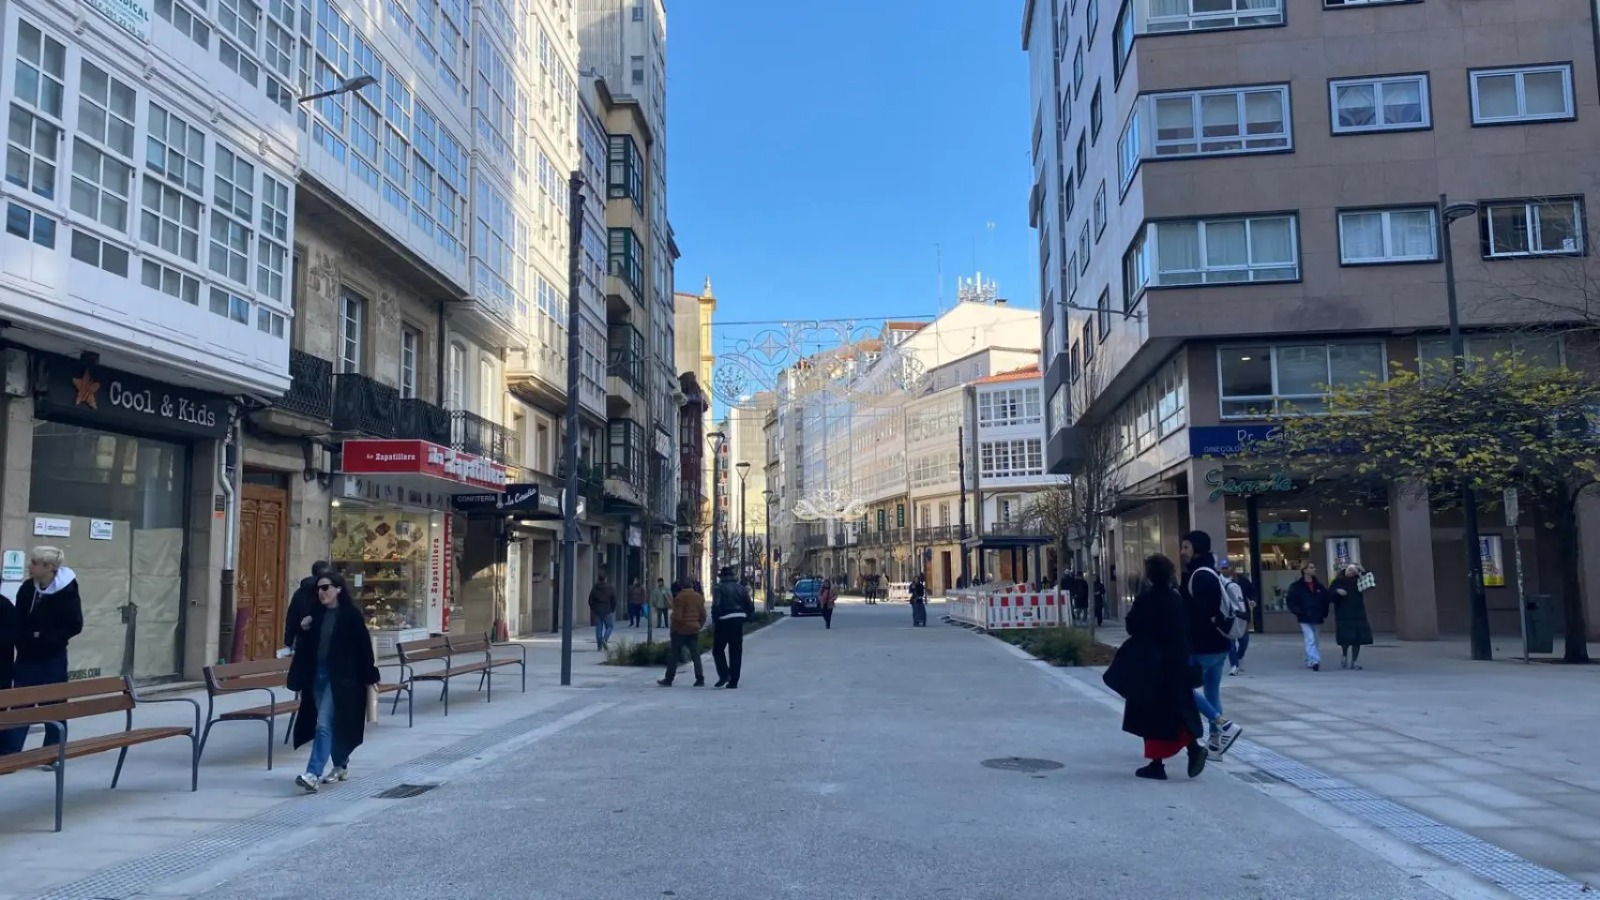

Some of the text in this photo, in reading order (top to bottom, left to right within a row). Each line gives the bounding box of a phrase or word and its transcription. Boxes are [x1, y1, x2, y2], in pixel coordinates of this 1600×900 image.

[109, 381, 216, 427] Cool & Kids
